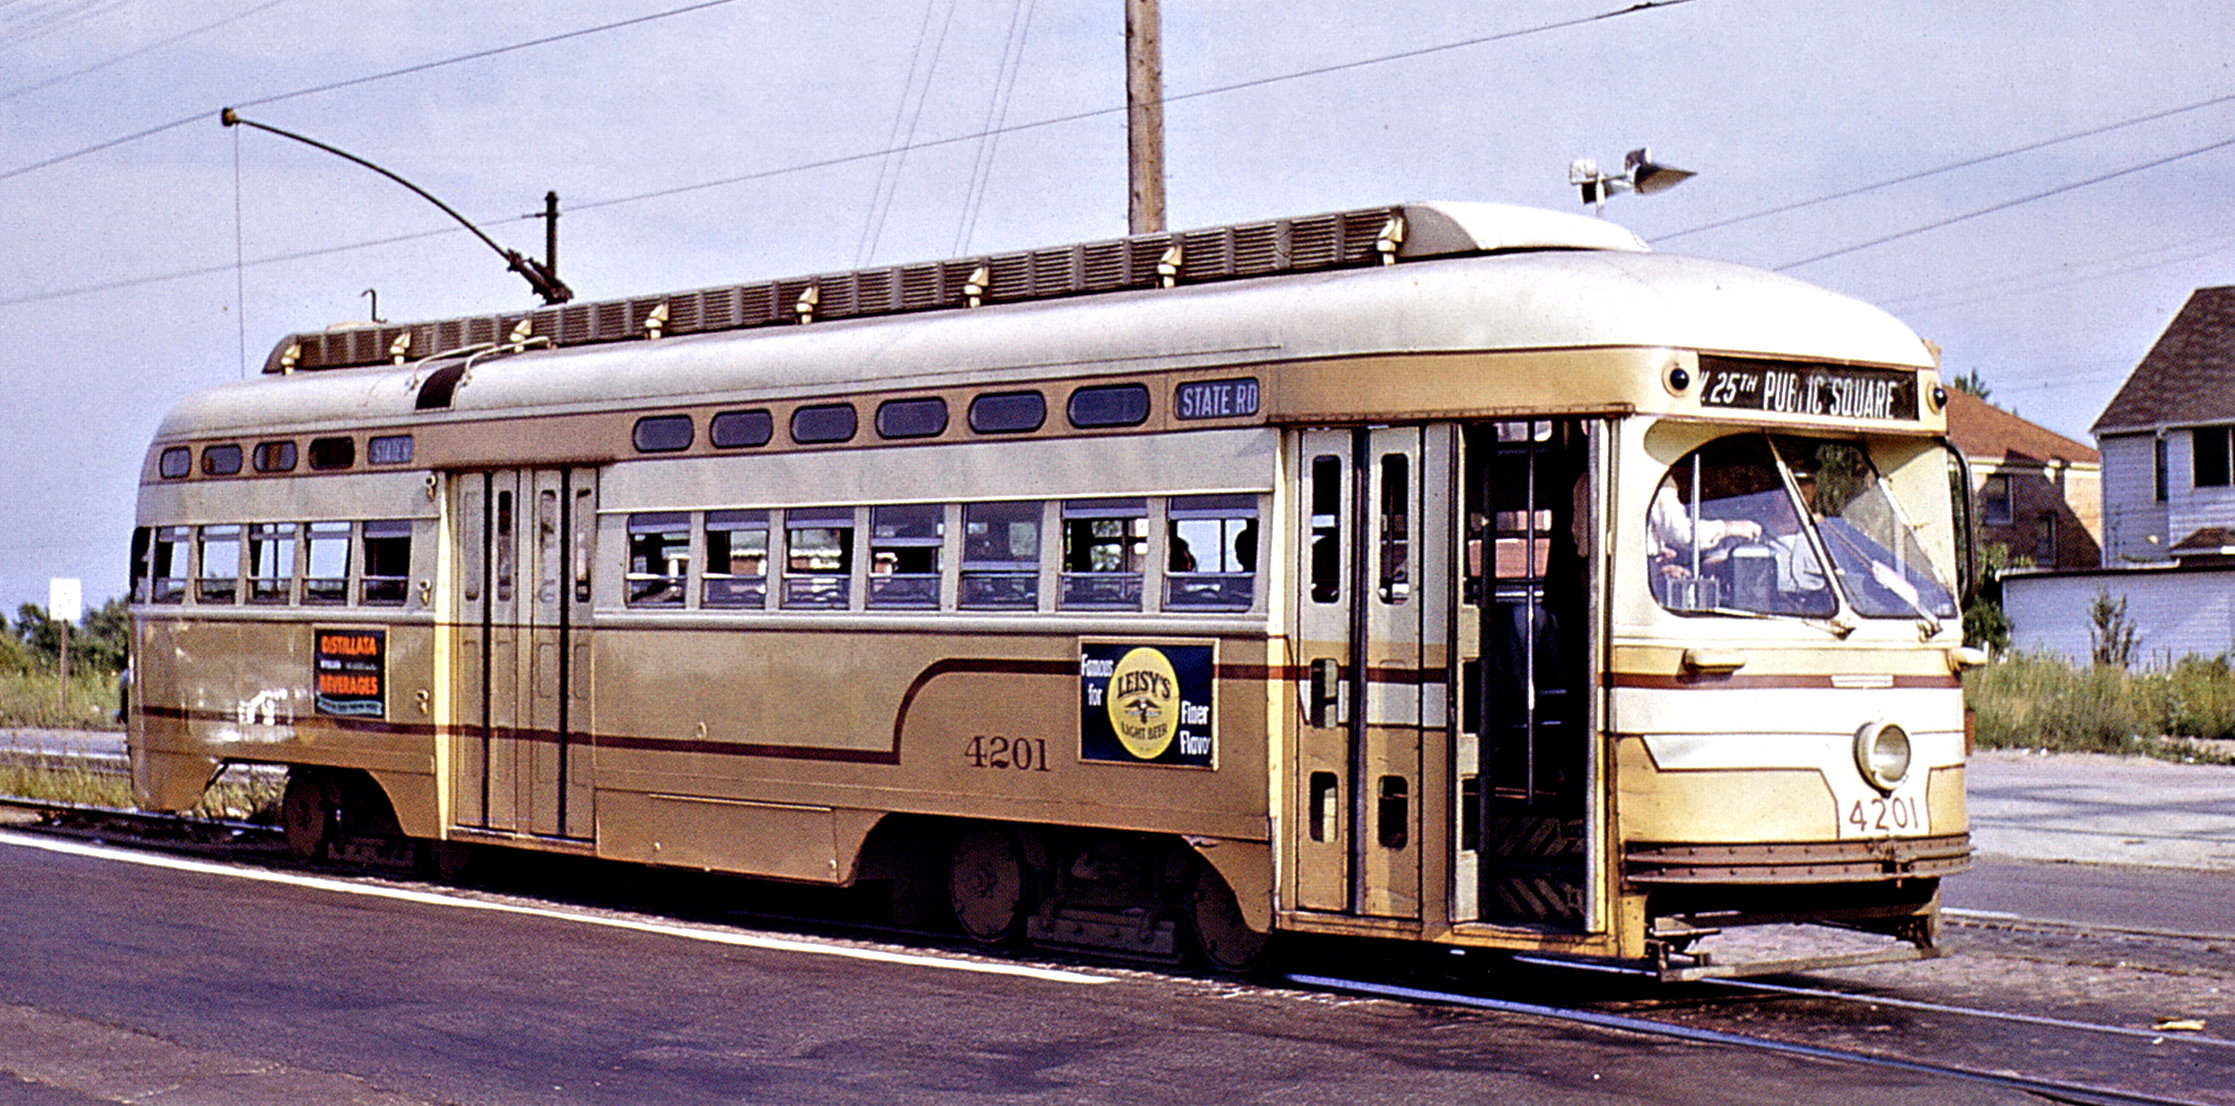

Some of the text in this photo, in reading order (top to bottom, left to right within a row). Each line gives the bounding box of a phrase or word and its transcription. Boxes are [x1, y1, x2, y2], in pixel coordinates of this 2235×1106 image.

[1183, 383, 1258, 416] STATE RD
[1710, 371, 1758, 404] 25TH
[1763, 370, 1824, 415] PUBIC
[1829, 377, 1898, 419] SQUARE
[321, 635, 377, 656] DISTILLATA
[1081, 653, 1114, 677] Famous
[319, 673, 379, 696] BEVERAGES
[1088, 683, 1103, 706] for
[1116, 670, 1171, 699] LEISY'S
[1181, 700, 1210, 725] Finer
[964, 735, 1051, 772] 4201
[1848, 796, 1919, 832] 4201
